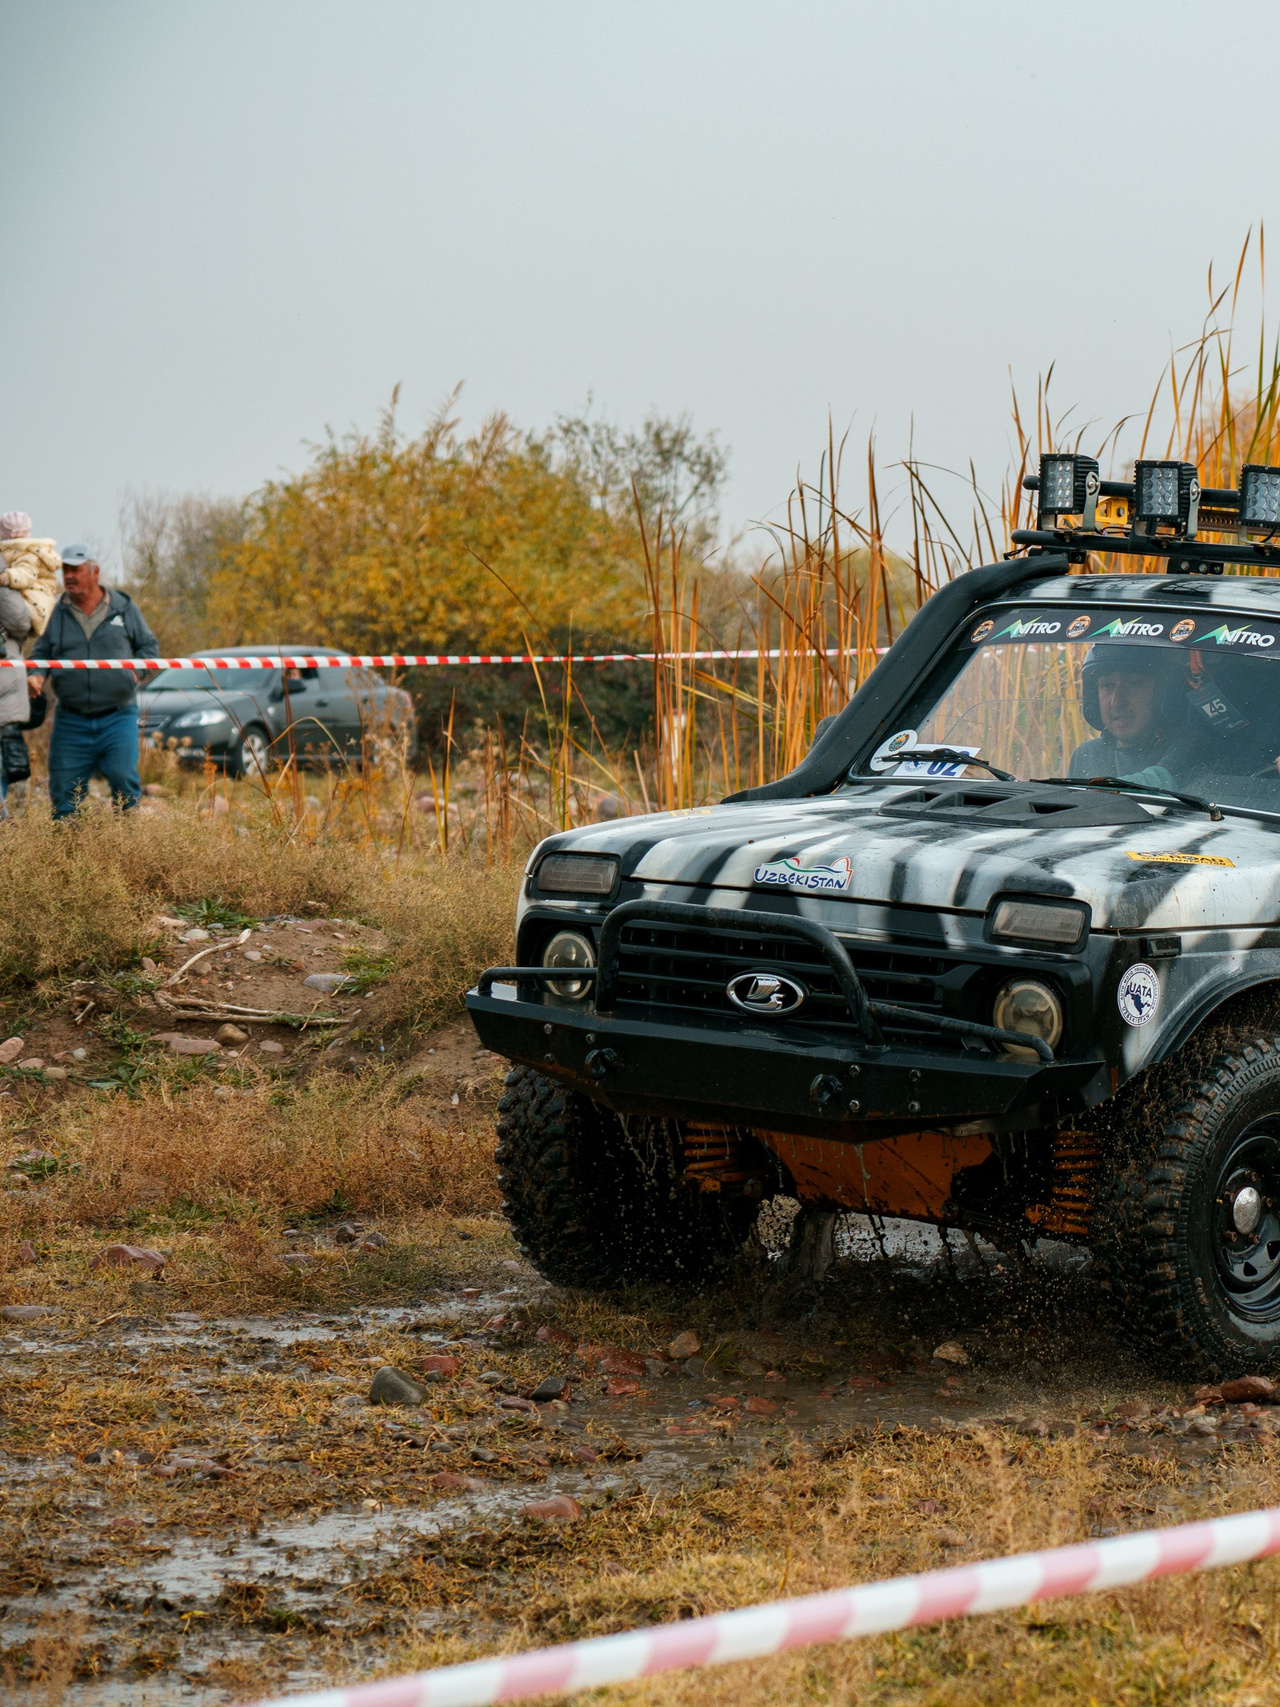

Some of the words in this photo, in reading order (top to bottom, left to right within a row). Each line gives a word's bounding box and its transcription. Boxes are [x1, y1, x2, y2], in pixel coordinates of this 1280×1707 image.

[1014, 621, 1061, 635] NITRO
[1112, 622, 1164, 636] NITRO
[1219, 629, 1275, 647] NITRO
[754, 868, 847, 889] UZBEKISTAN
[1129, 981, 1152, 999] UATA
